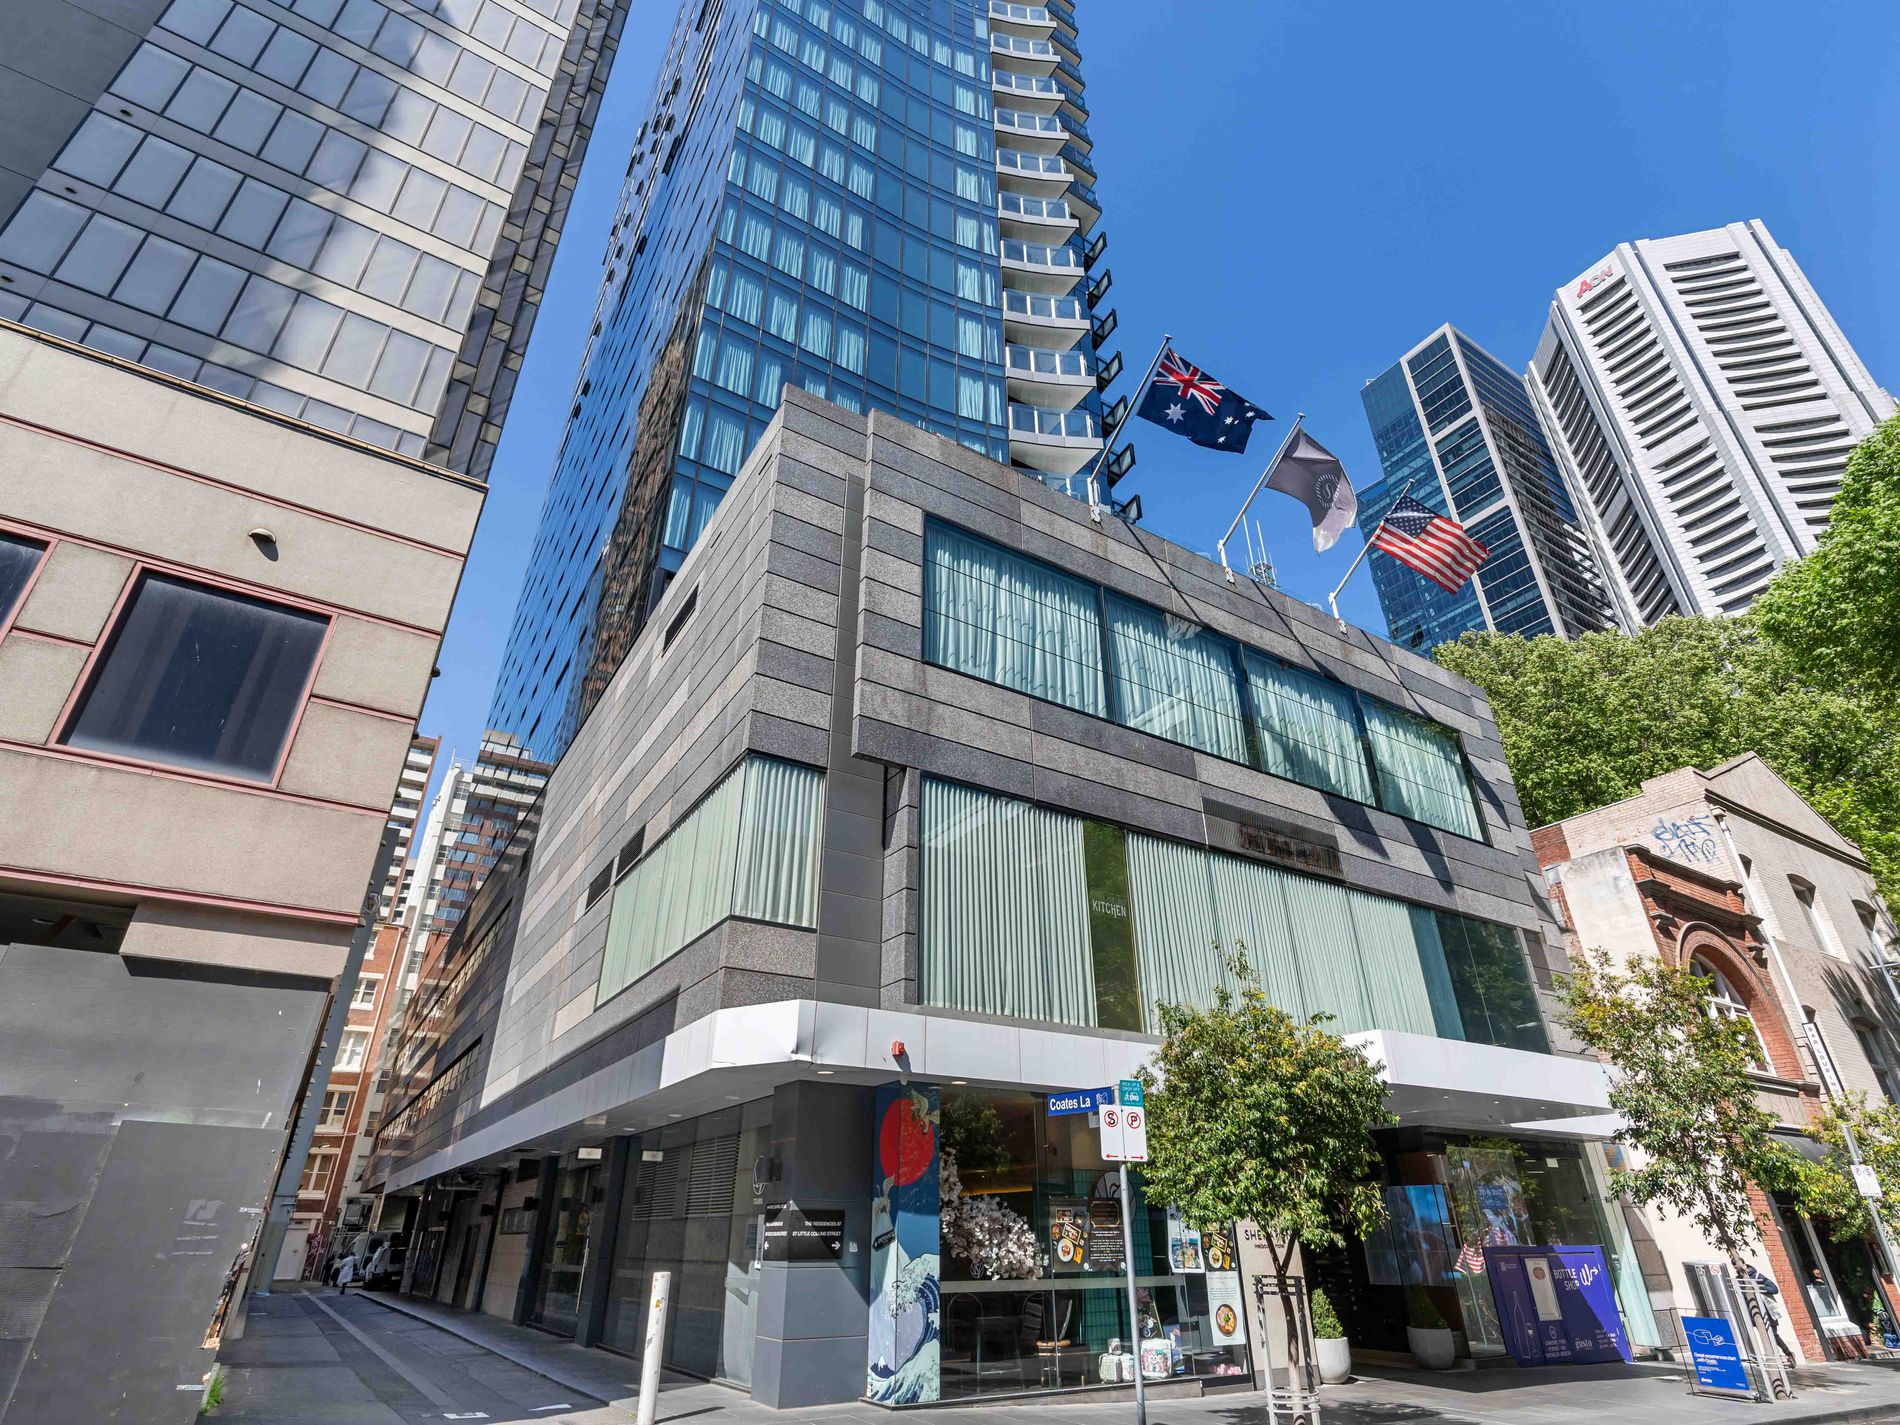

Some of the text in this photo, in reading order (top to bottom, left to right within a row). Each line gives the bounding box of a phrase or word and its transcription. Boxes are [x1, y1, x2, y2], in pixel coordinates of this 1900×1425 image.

[1092, 899, 1127, 919] KITCHEN
[1050, 1096, 1091, 1111] Coates La
[1553, 1268, 1578, 1280] BOTTLE
[1564, 1280, 1580, 1291] SHOP
